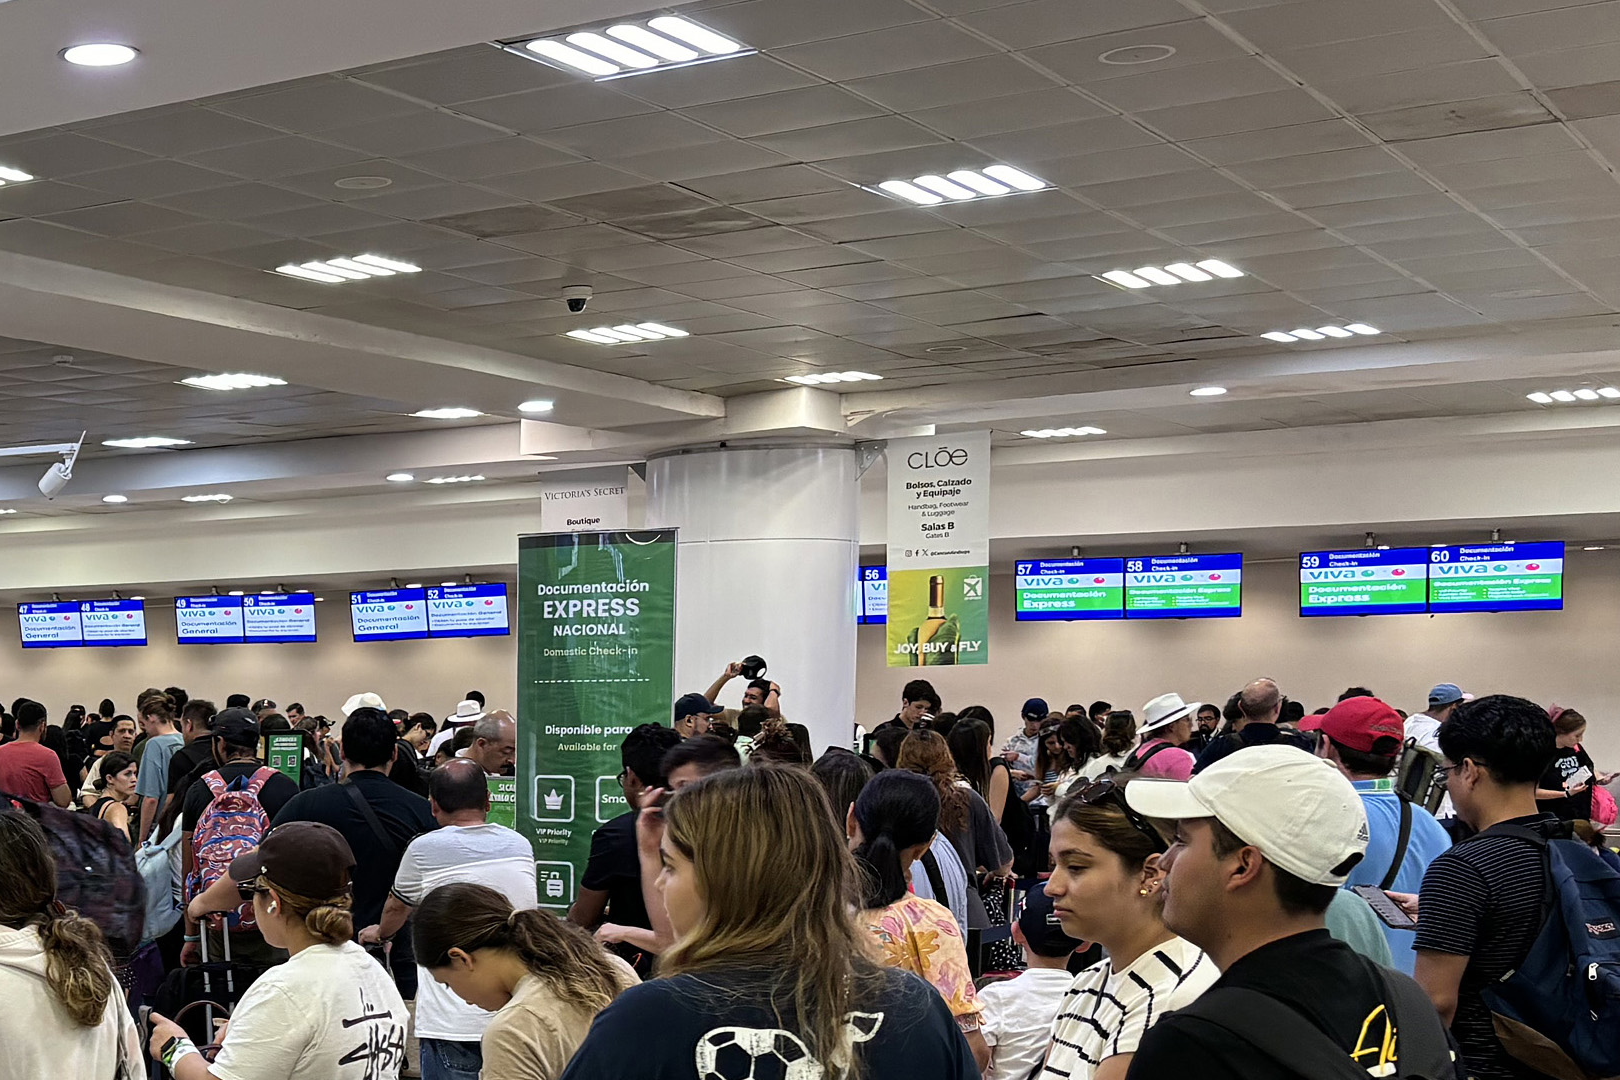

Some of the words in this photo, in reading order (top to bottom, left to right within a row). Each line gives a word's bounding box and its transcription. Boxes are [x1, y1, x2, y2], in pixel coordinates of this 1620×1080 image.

[936, 478, 972, 488] Calzado
[544, 488, 591, 501] VICTORIA'S
[593, 486, 626, 498] SECRET
[916, 490, 922, 499] y
[923, 487, 961, 498] Equipaje
[927, 510, 955, 518] Luggage
[566, 517, 601, 527] Boutique
[921, 522, 946, 532] Salas
[947, 521, 955, 530] B
[1302, 556, 1320, 568] 59
[1431, 550, 1450, 563] 60
[1017, 564, 1032, 575] 57
[1127, 561, 1143, 572] 58
[865, 570, 879, 580] 56
[538, 579, 650, 596] Documentación
[351, 594, 362, 603] 51
[427, 590, 438, 599] 52
[1308, 593, 1370, 604] Express
[176, 599, 186, 608] 49
[243, 597, 254, 606] 50
[1023, 599, 1076, 610] Express
[19, 605, 29, 614] 47
[543, 598, 640, 619] EXPRESS
[358, 623, 399, 631] General
[553, 623, 626, 637] NACIONAL
[544, 647, 587, 656] Domestic
[588, 645, 638, 657] Check-in
[921, 642, 949, 653] BUY
[958, 640, 982, 652] FLY
[545, 724, 602, 737] Disponible
[603, 726, 633, 738] para
[558, 743, 602, 751] Available
[602, 743, 618, 751] for
[535, 828, 546, 836] VIP
[547, 828, 572, 838] Priority
